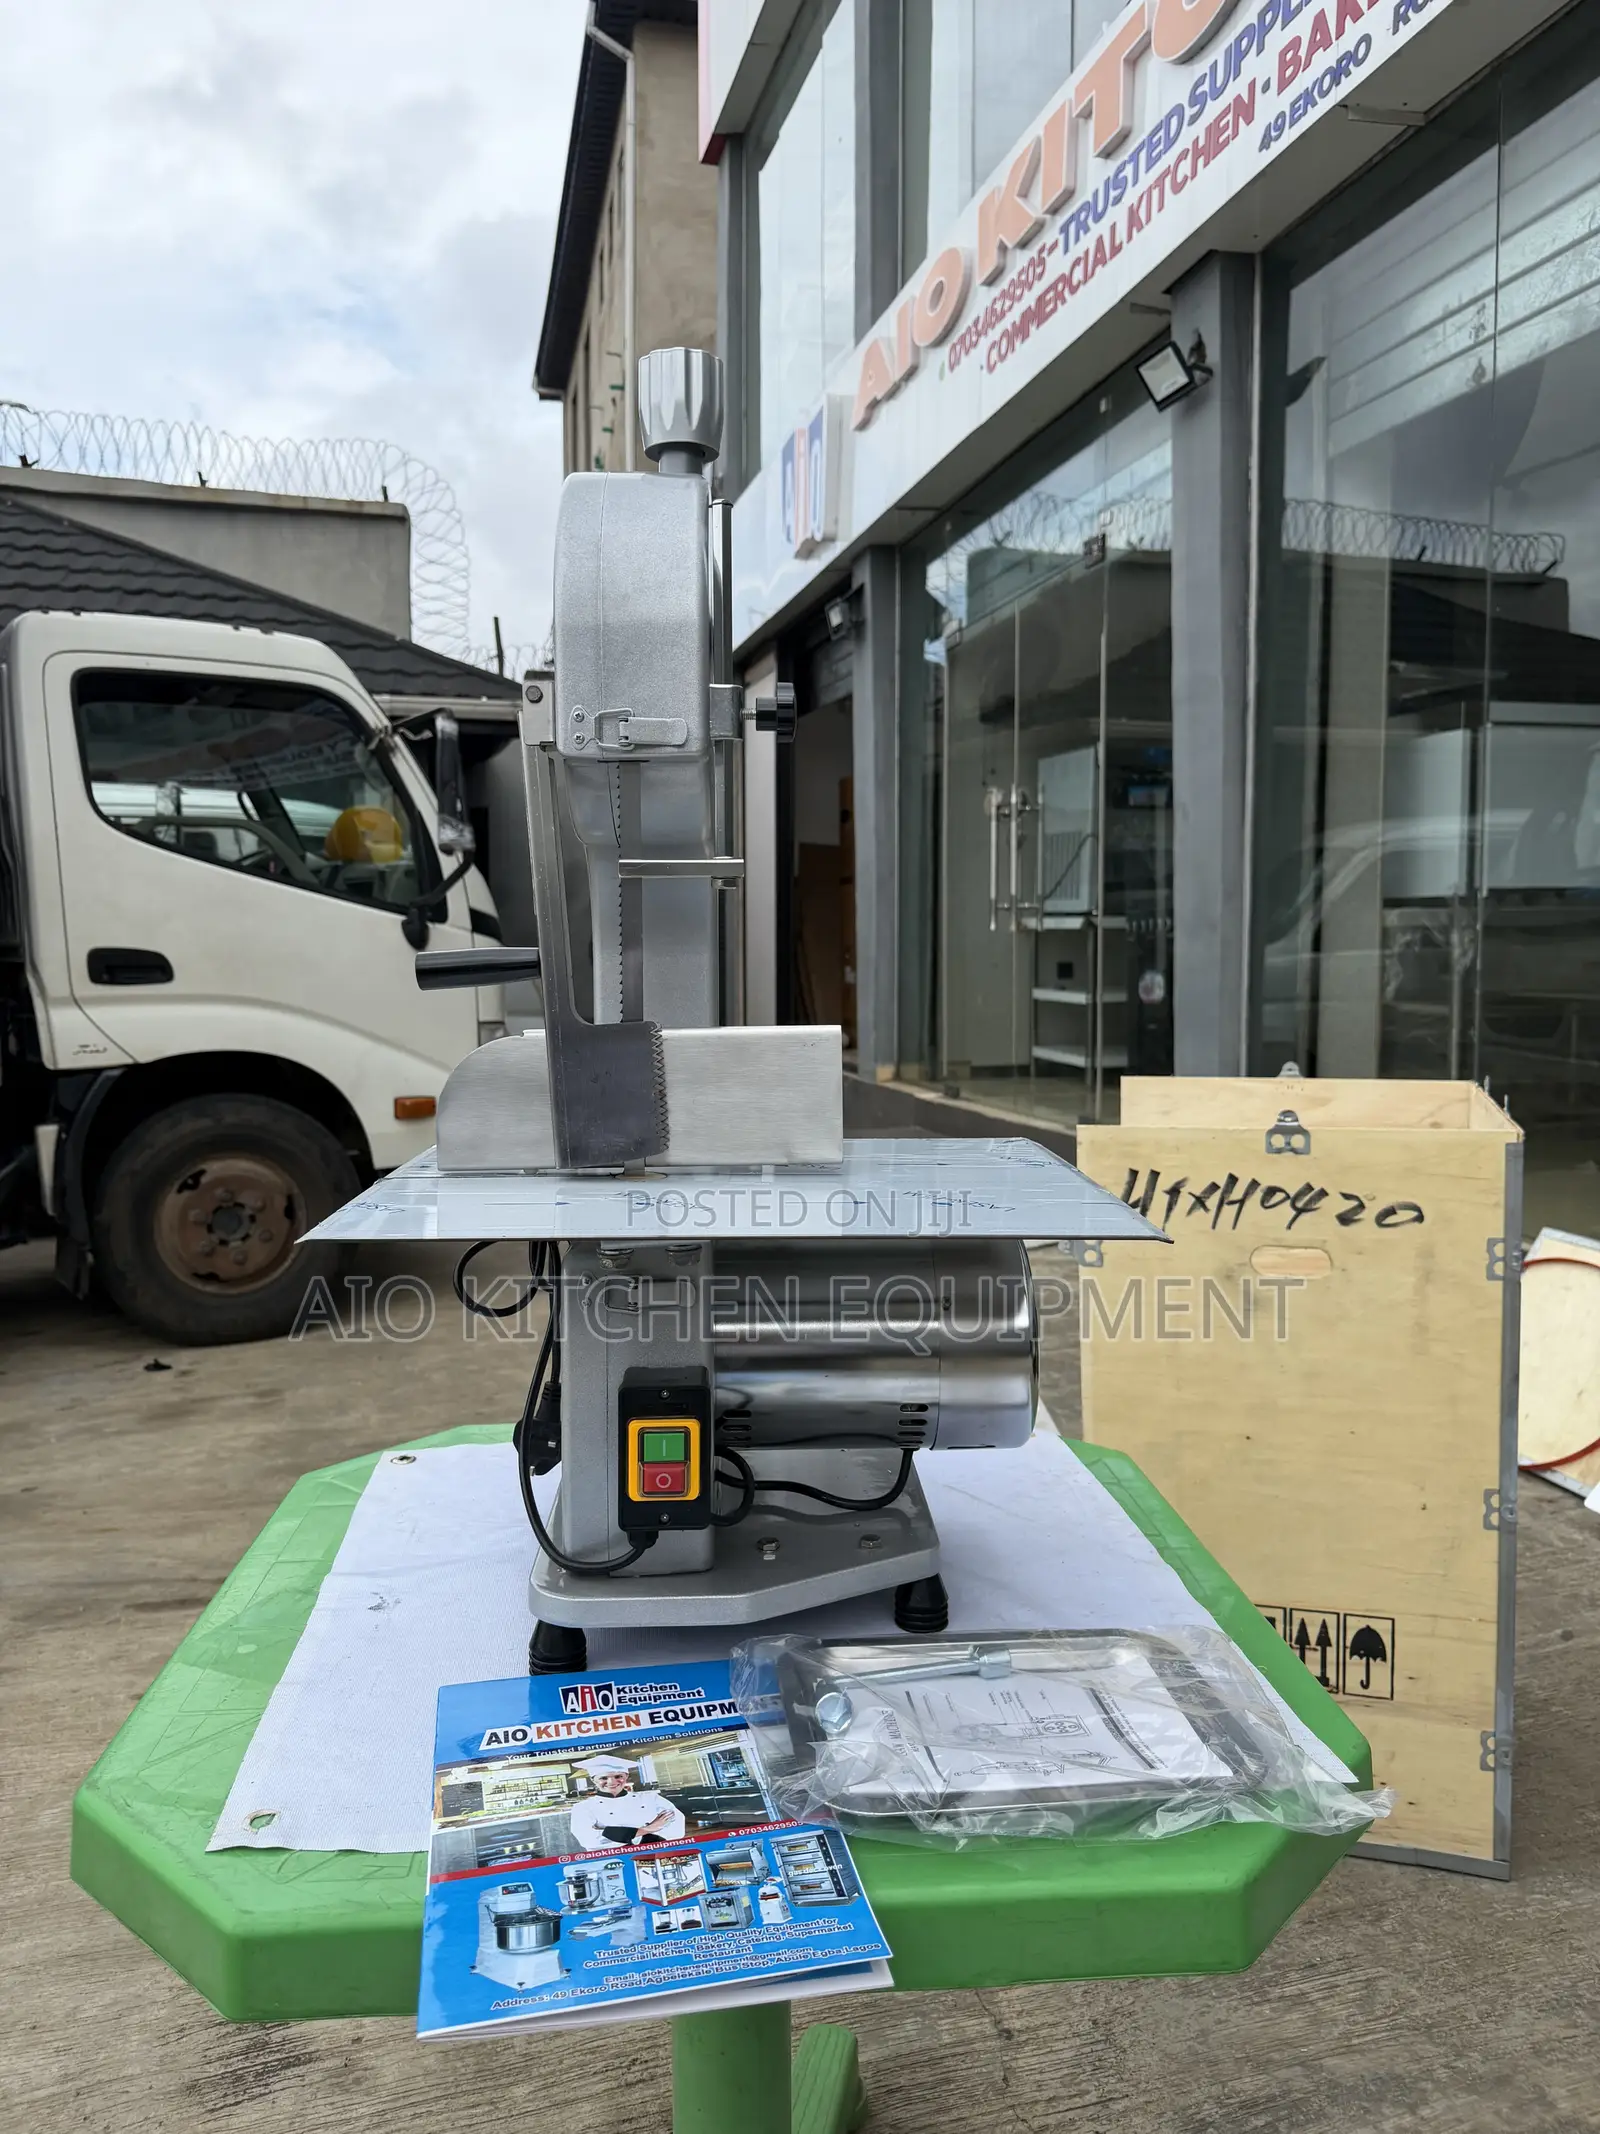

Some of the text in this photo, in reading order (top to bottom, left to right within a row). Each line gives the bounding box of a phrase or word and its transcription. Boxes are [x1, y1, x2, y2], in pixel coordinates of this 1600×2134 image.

[1258, 110, 1288, 153] 49
[1288, 33, 1373, 129] EKORO
[1058, 102, 1186, 256] TRUSTED
[1187, 0, 1311, 127] SUPPL
[986, 0, 1379, 374] COMMERCIAL KITCHEN BAK
[853, 247, 970, 431] AIO
[616, 1682, 679, 1695] Kitchen
[617, 1688, 704, 1706] Equipment
[485, 1698, 762, 1747] AIO KITCHEN EQUIPM
[504, 1726, 725, 1762] Your Trusted Partner in Kitchen Solutions
[574, 1837, 696, 1861] @aiokitchenequipment
[583, 1923, 853, 1968] Commercial kitchen, Bakery, Catering, Supermarket
[596, 1918, 839, 1958] Trusted Supplier of High Quality Equipment for
[693, 1946, 752, 1960] Restaurant
[492, 1994, 549, 2009] Address:
[552, 1990, 567, 1999] 49
[570, 1985, 607, 1997] Ekoro
[715, 1964, 739, 1974] Bus
[741, 1958, 773, 1970] Stop,
